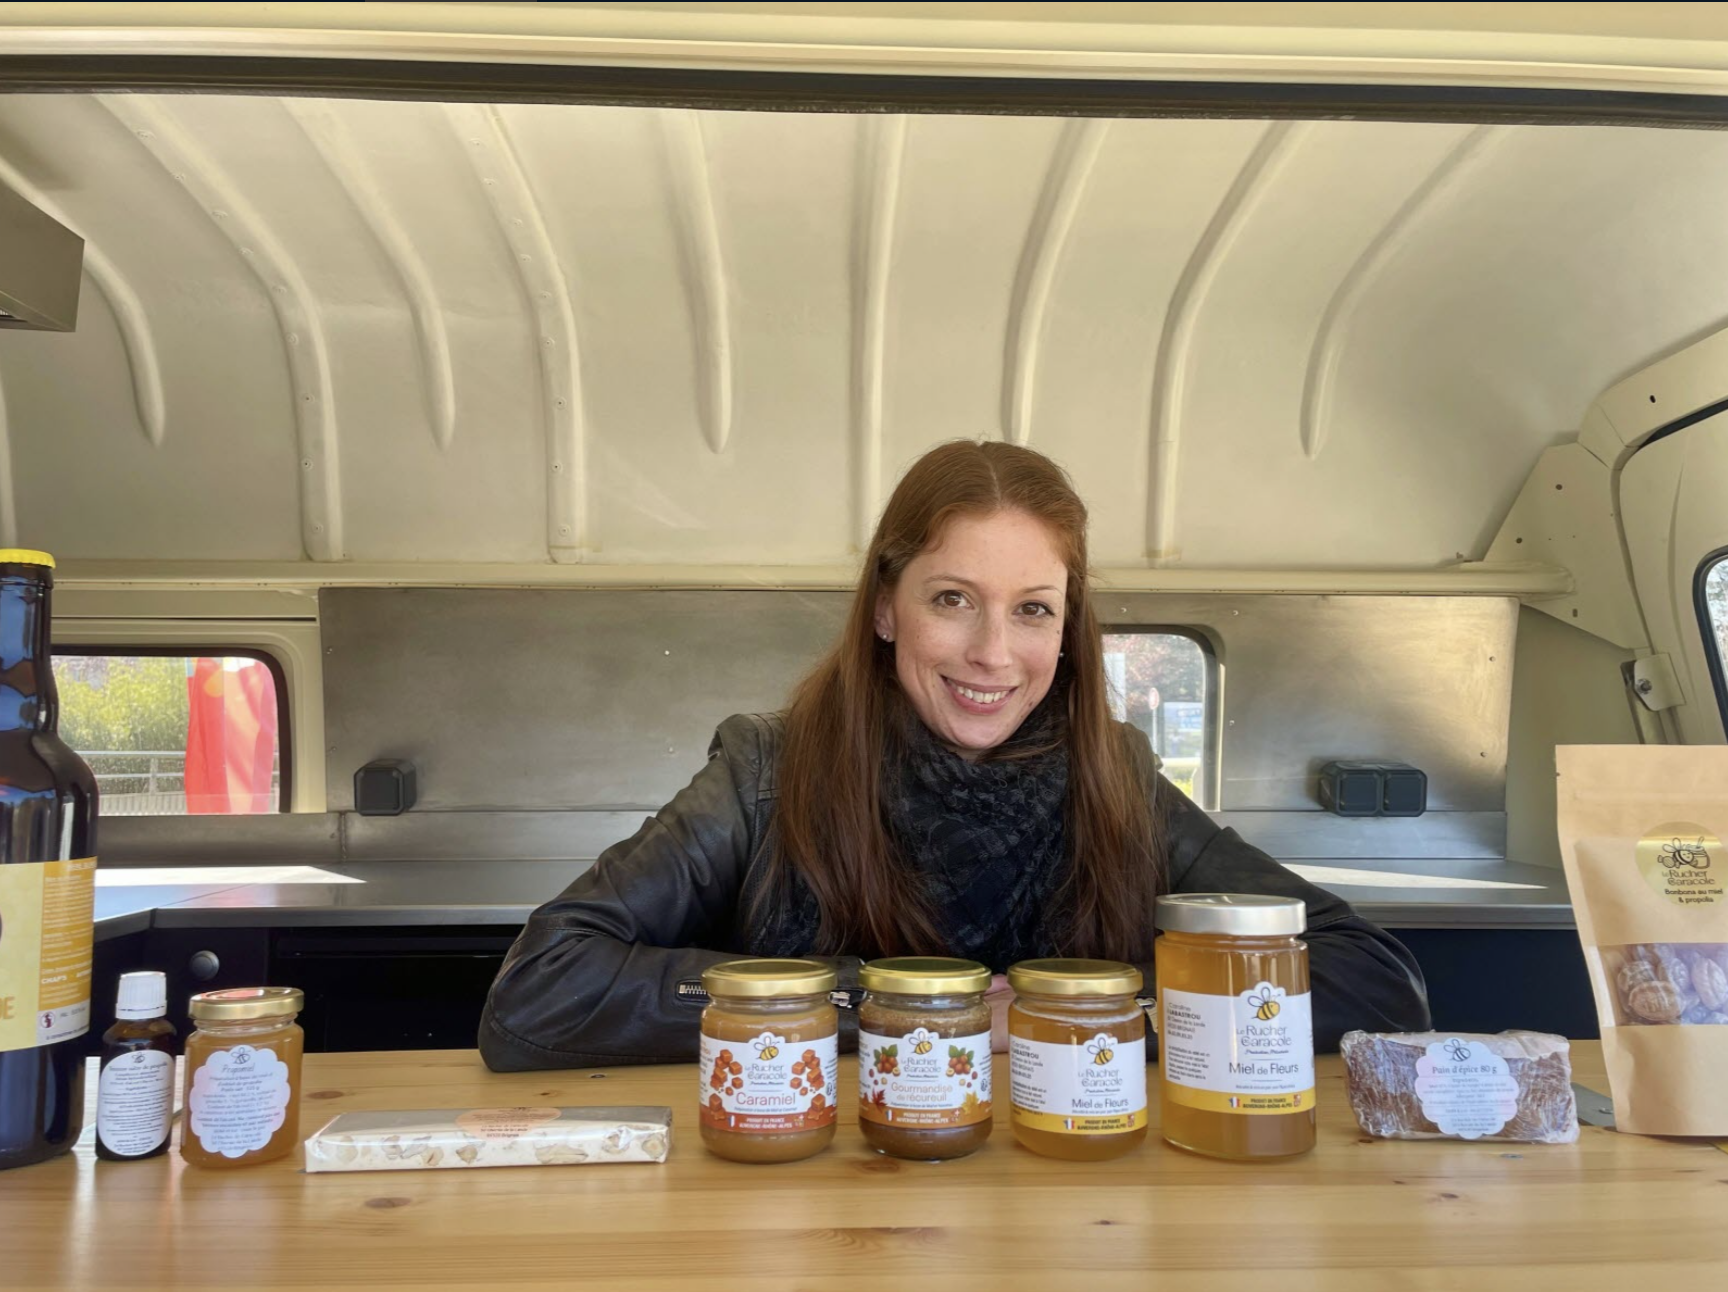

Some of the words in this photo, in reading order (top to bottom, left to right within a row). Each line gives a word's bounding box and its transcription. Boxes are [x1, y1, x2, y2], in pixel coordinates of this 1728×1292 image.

[1669, 870, 1707, 878] Rucher
[1685, 896, 1714, 904] propolis
[0, 997, 15, 1020] E
[1246, 1025, 1287, 1036] Rucher
[1241, 1036, 1292, 1047] Caracole
[907, 1056, 937, 1066] Rucher
[222, 1062, 256, 1074] Propomiel
[752, 1064, 784, 1072] Rucher
[1086, 1068, 1119, 1078] Rucher
[1229, 1062, 1255, 1075] Miel
[1257, 1066, 1268, 1075] de
[1270, 1062, 1299, 1075] Fleurs
[1432, 1066, 1450, 1074] Pain
[1452, 1065, 1478, 1076] d'épice
[1492, 1066, 1498, 1074] g
[892, 1082, 953, 1093] Gourmandise
[736, 1092, 796, 1106] Caramiel
[1072, 1098, 1092, 1108] Miel
[1105, 1098, 1129, 1108] Fleurs
